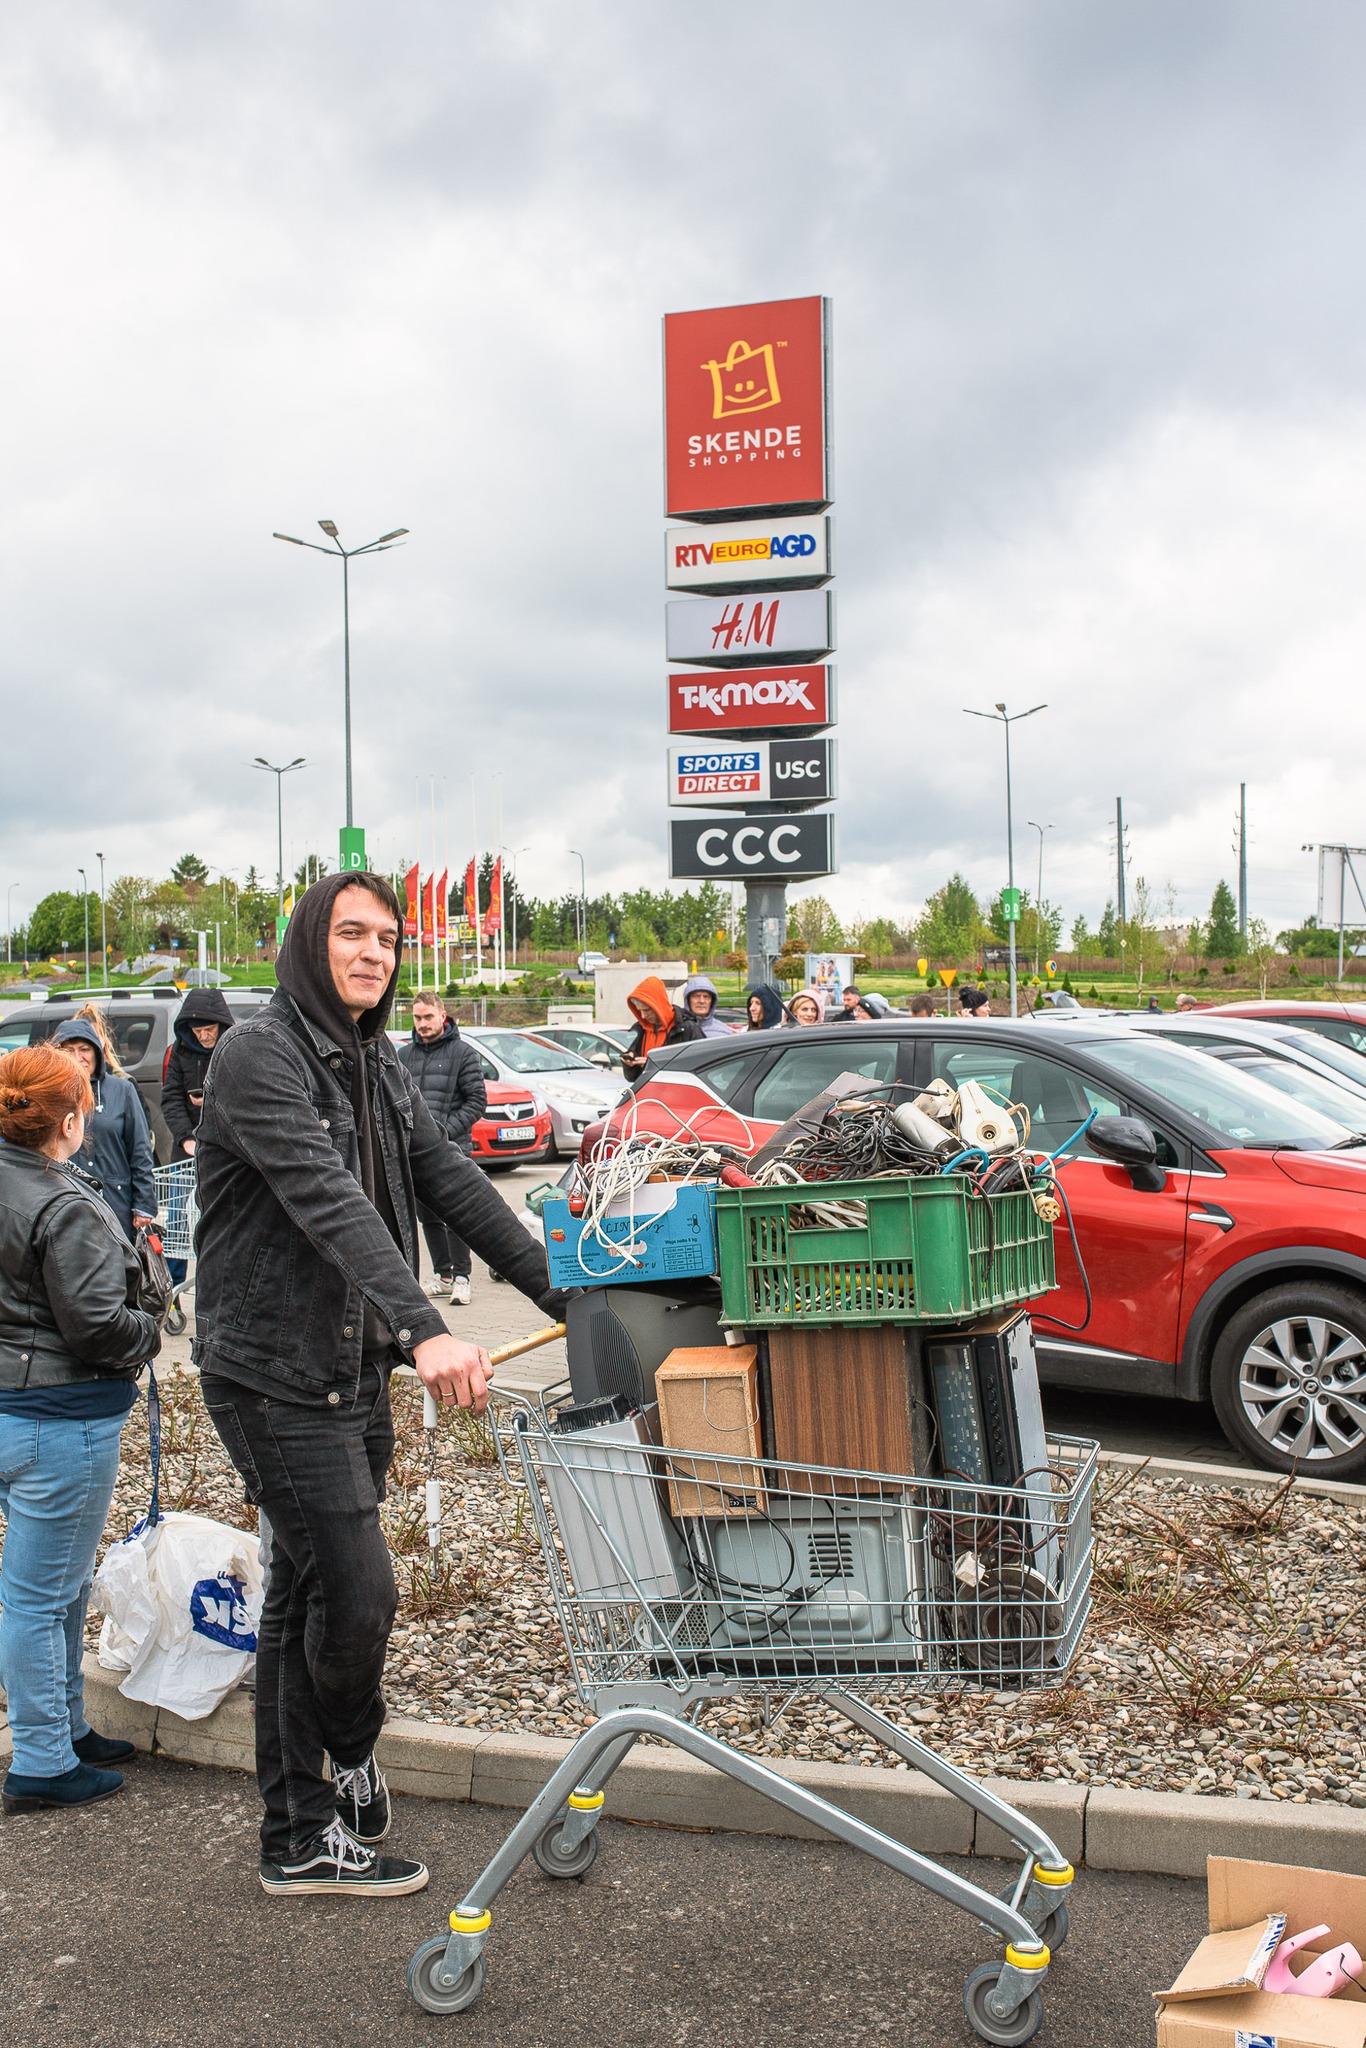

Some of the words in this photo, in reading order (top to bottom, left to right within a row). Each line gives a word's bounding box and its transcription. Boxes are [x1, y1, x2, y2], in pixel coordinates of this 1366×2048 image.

[688, 425, 801, 455] SKENDE
[689, 448, 801, 467] SHOPPING
[675, 543, 713, 568] RTV
[716, 543, 768, 558] EURO
[770, 534, 816, 558] AGD
[712, 600, 780, 650] H&M
[683, 754, 755, 772] SPORTS
[775, 760, 821, 779] USC
[683, 775, 755, 793] DIRECT
[696, 824, 802, 866] CCC
[351, 852, 361, 868] D
[1005, 903, 1010, 913] D
[1013, 902, 1019, 914] D
